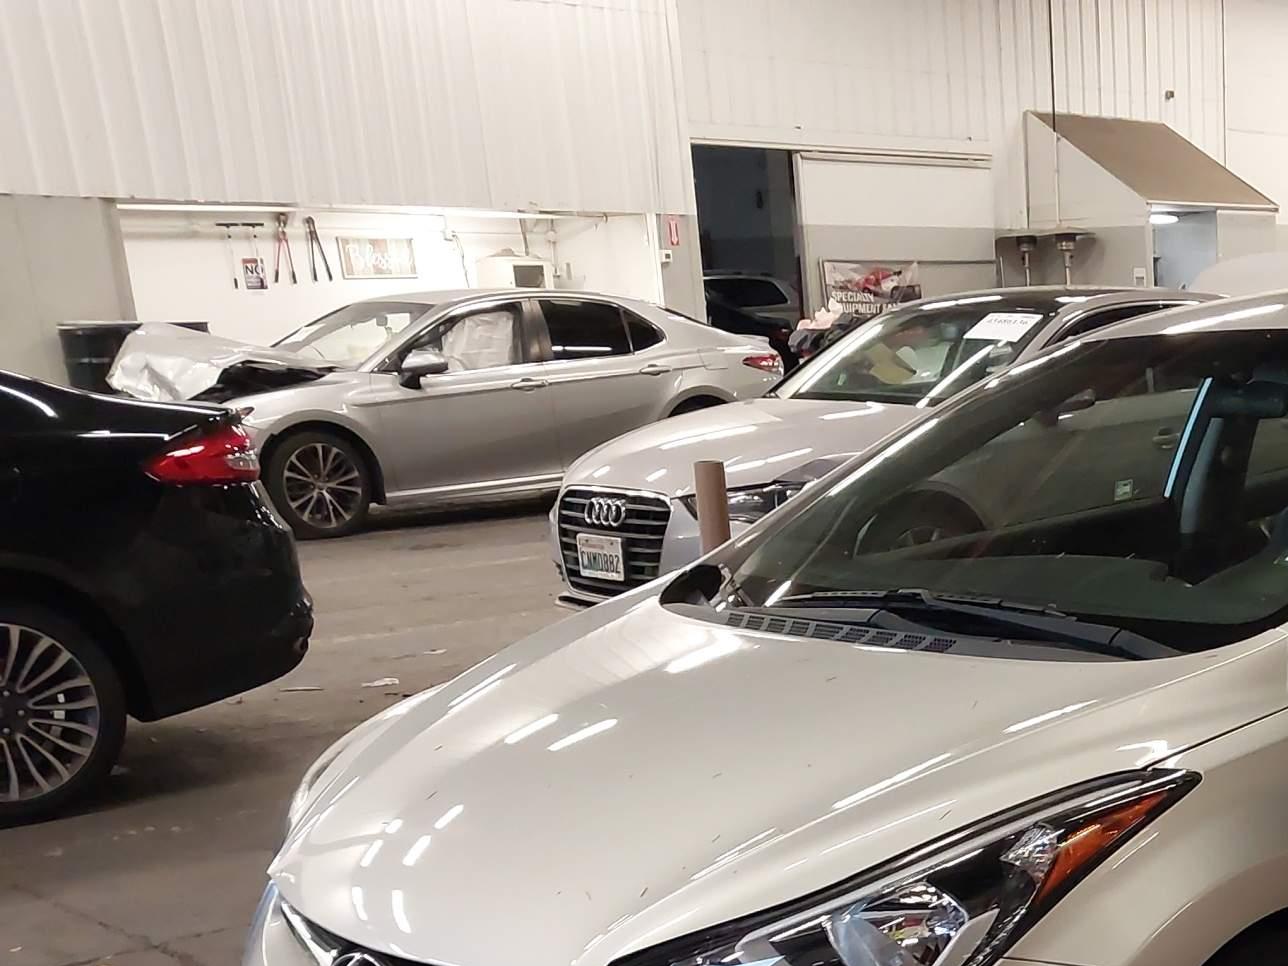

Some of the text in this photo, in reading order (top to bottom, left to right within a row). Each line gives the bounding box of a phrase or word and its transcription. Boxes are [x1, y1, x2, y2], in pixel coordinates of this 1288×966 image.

[245, 264, 264, 275] NO
[831, 291, 875, 303] SPECIALTY
[842, 303, 881, 314] UIPMENT
